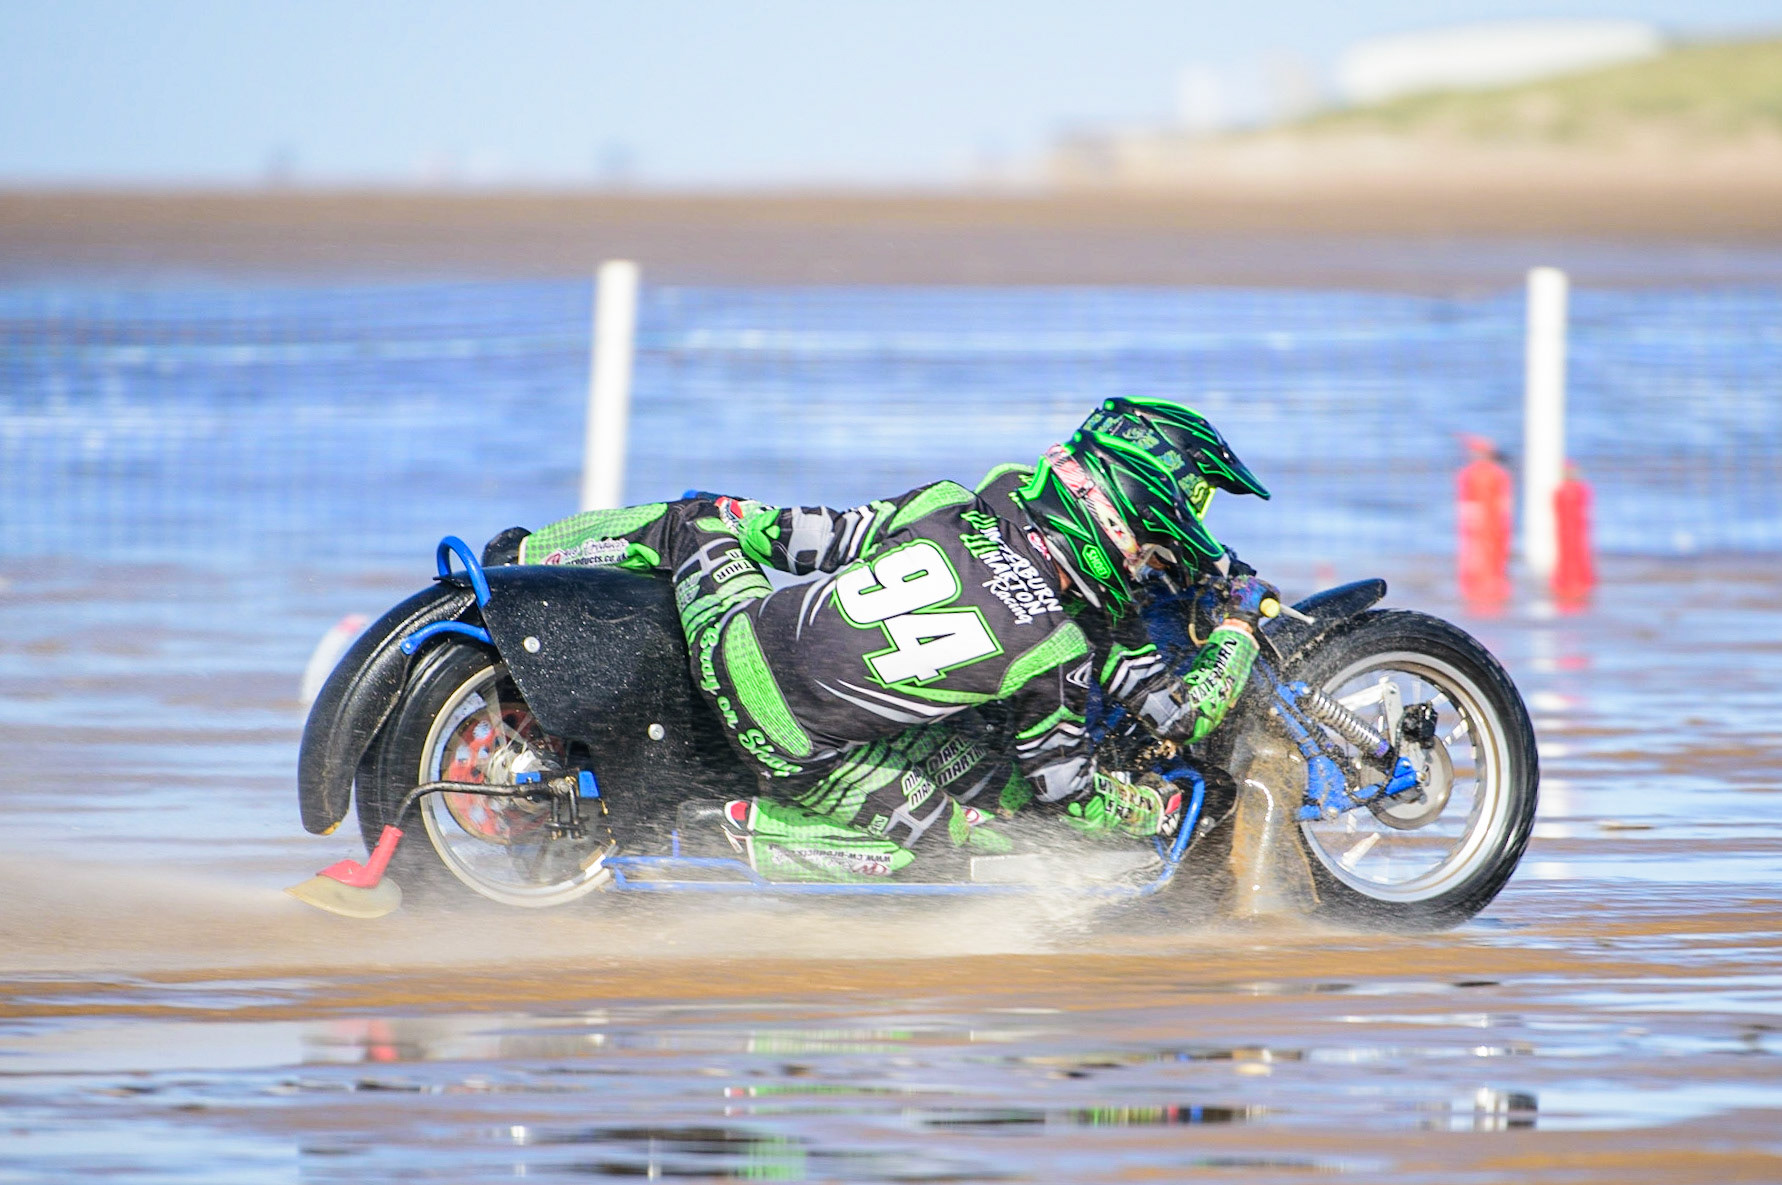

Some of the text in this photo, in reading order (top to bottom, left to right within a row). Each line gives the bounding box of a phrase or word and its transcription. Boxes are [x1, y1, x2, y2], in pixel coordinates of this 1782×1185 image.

[836, 541, 1001, 686] 94
[981, 574, 1034, 626] Racing
[717, 695, 740, 730] on
